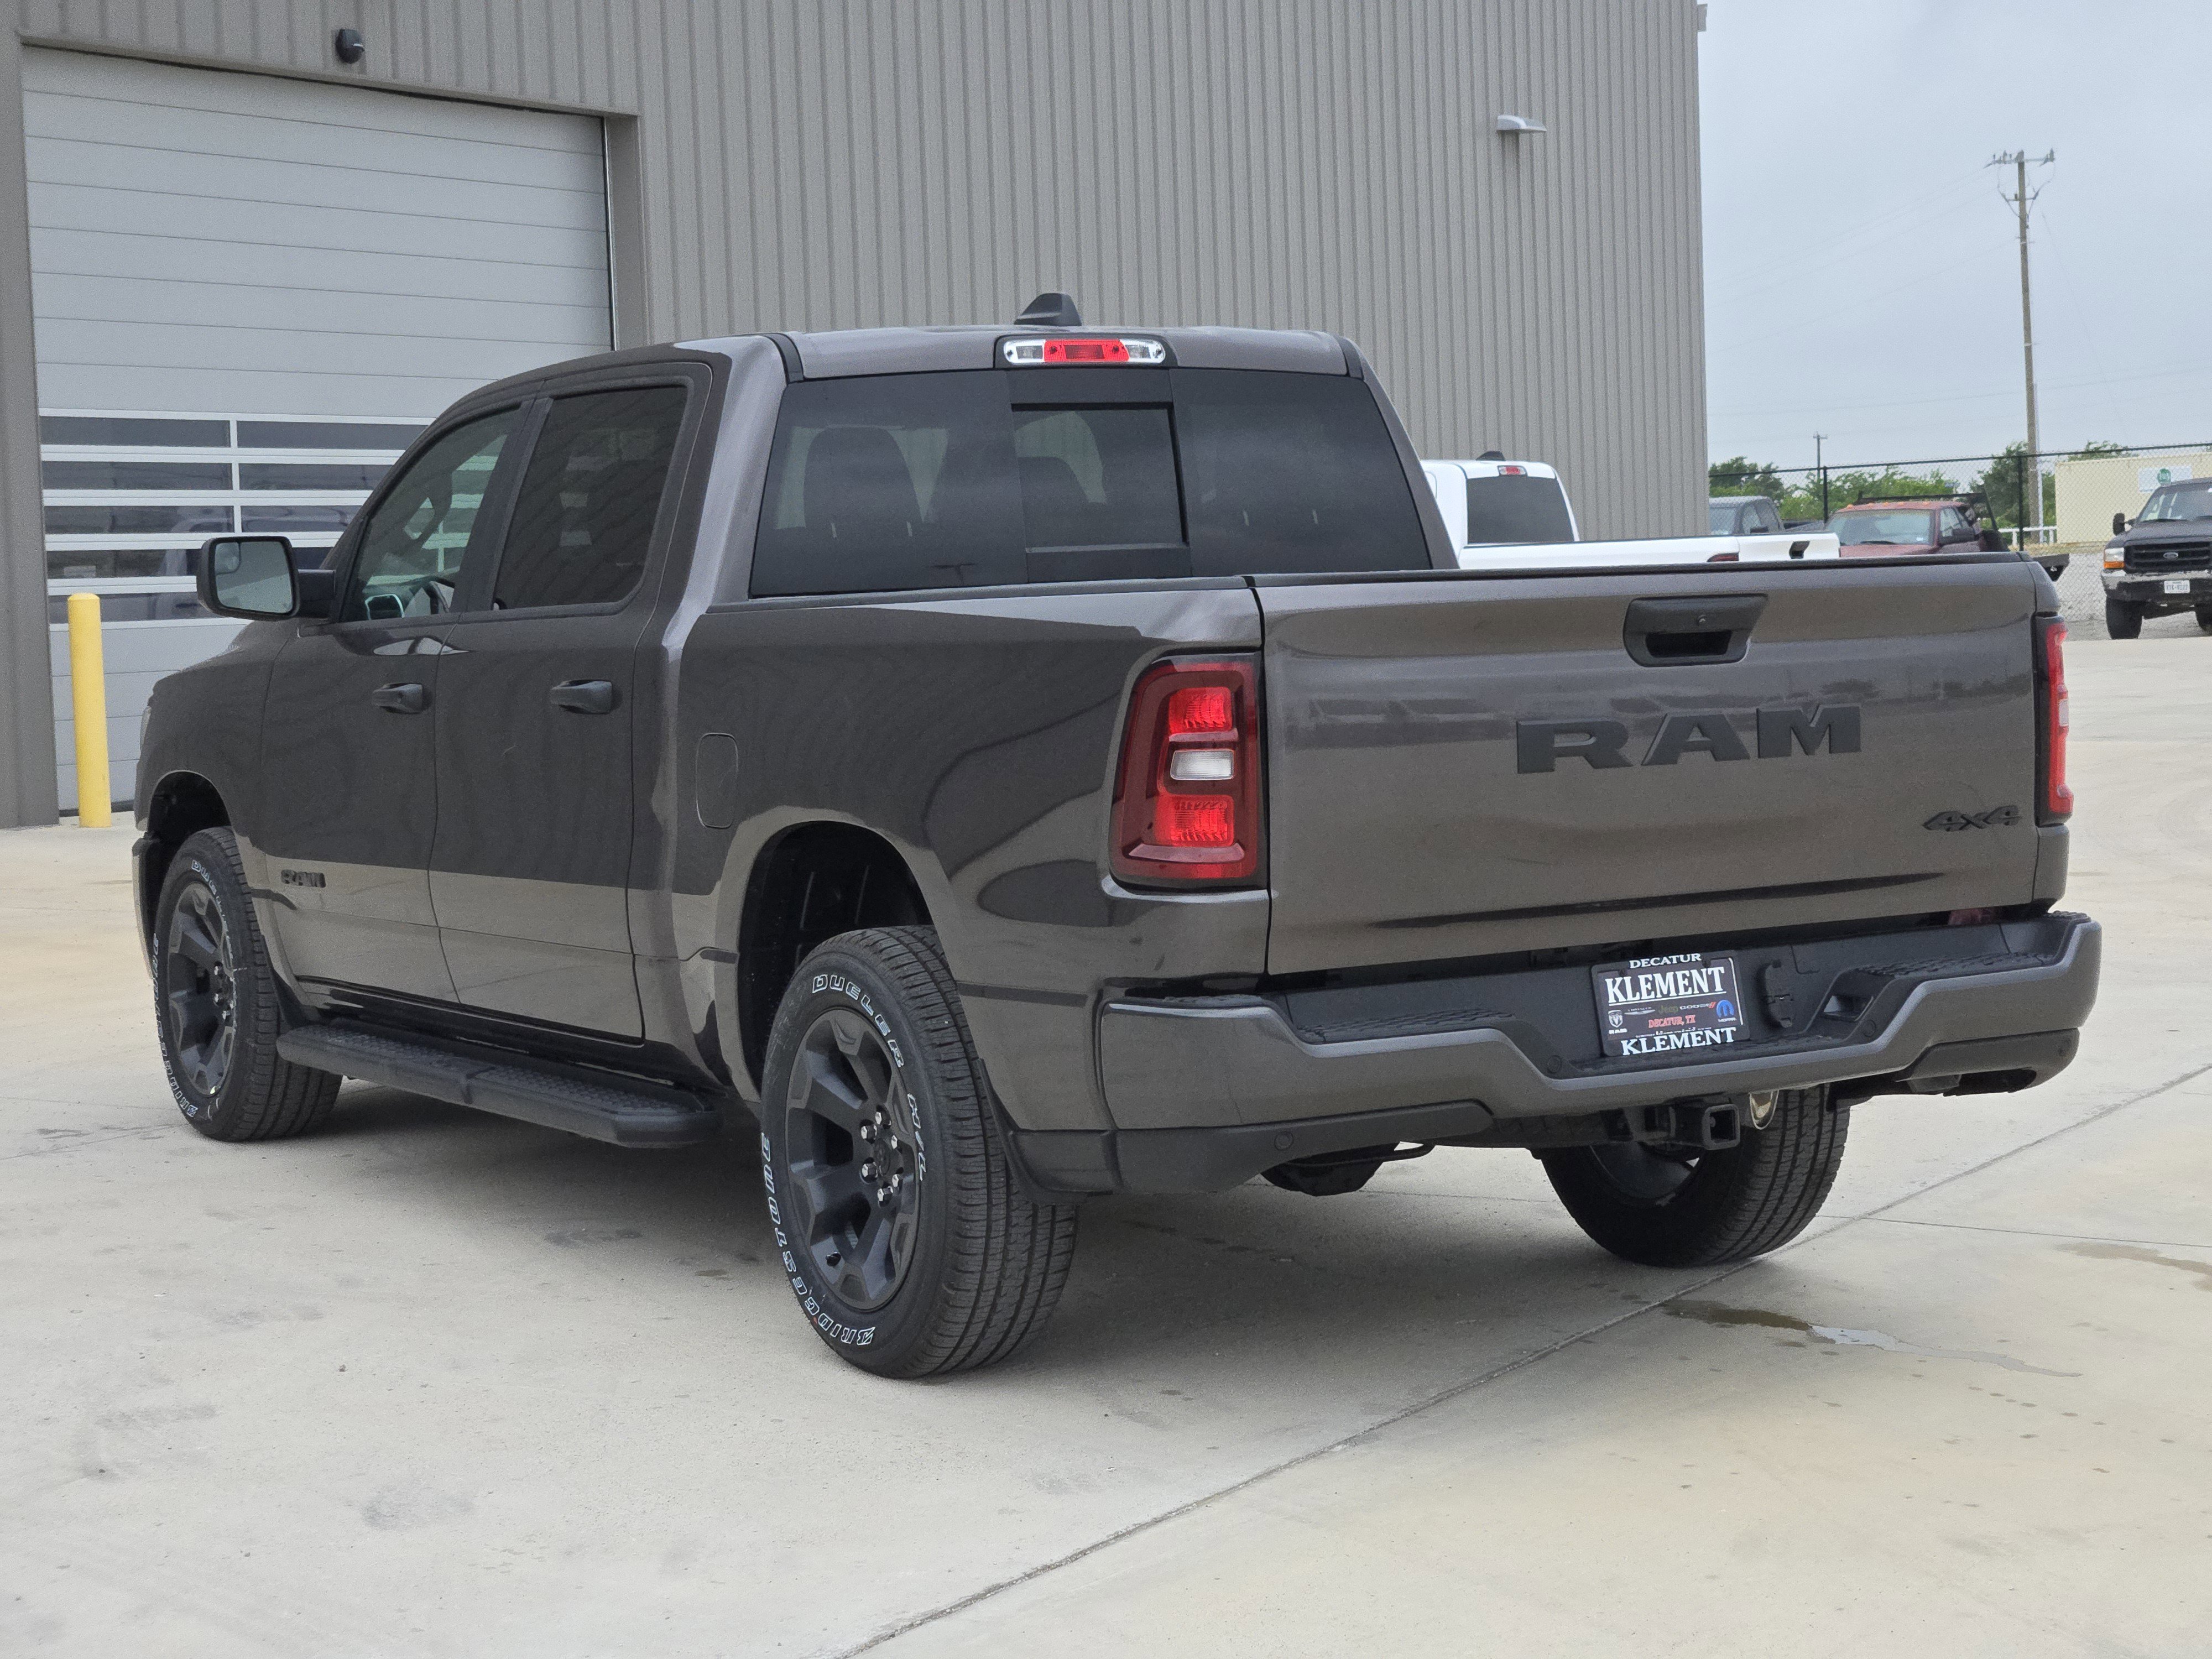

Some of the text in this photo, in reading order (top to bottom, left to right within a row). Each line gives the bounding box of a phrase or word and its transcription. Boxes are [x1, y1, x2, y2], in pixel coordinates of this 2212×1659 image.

[1516, 703, 1861, 774] RAM
[1605, 967, 1724, 1003] KLEMENT
[1629, 953, 1702, 968] DECATUR
[812, 974, 904, 1068] DUELER
[1621, 1027, 1736, 1055] KLEMENT
[761, 1132, 875, 1346] BRIDGESTONE
